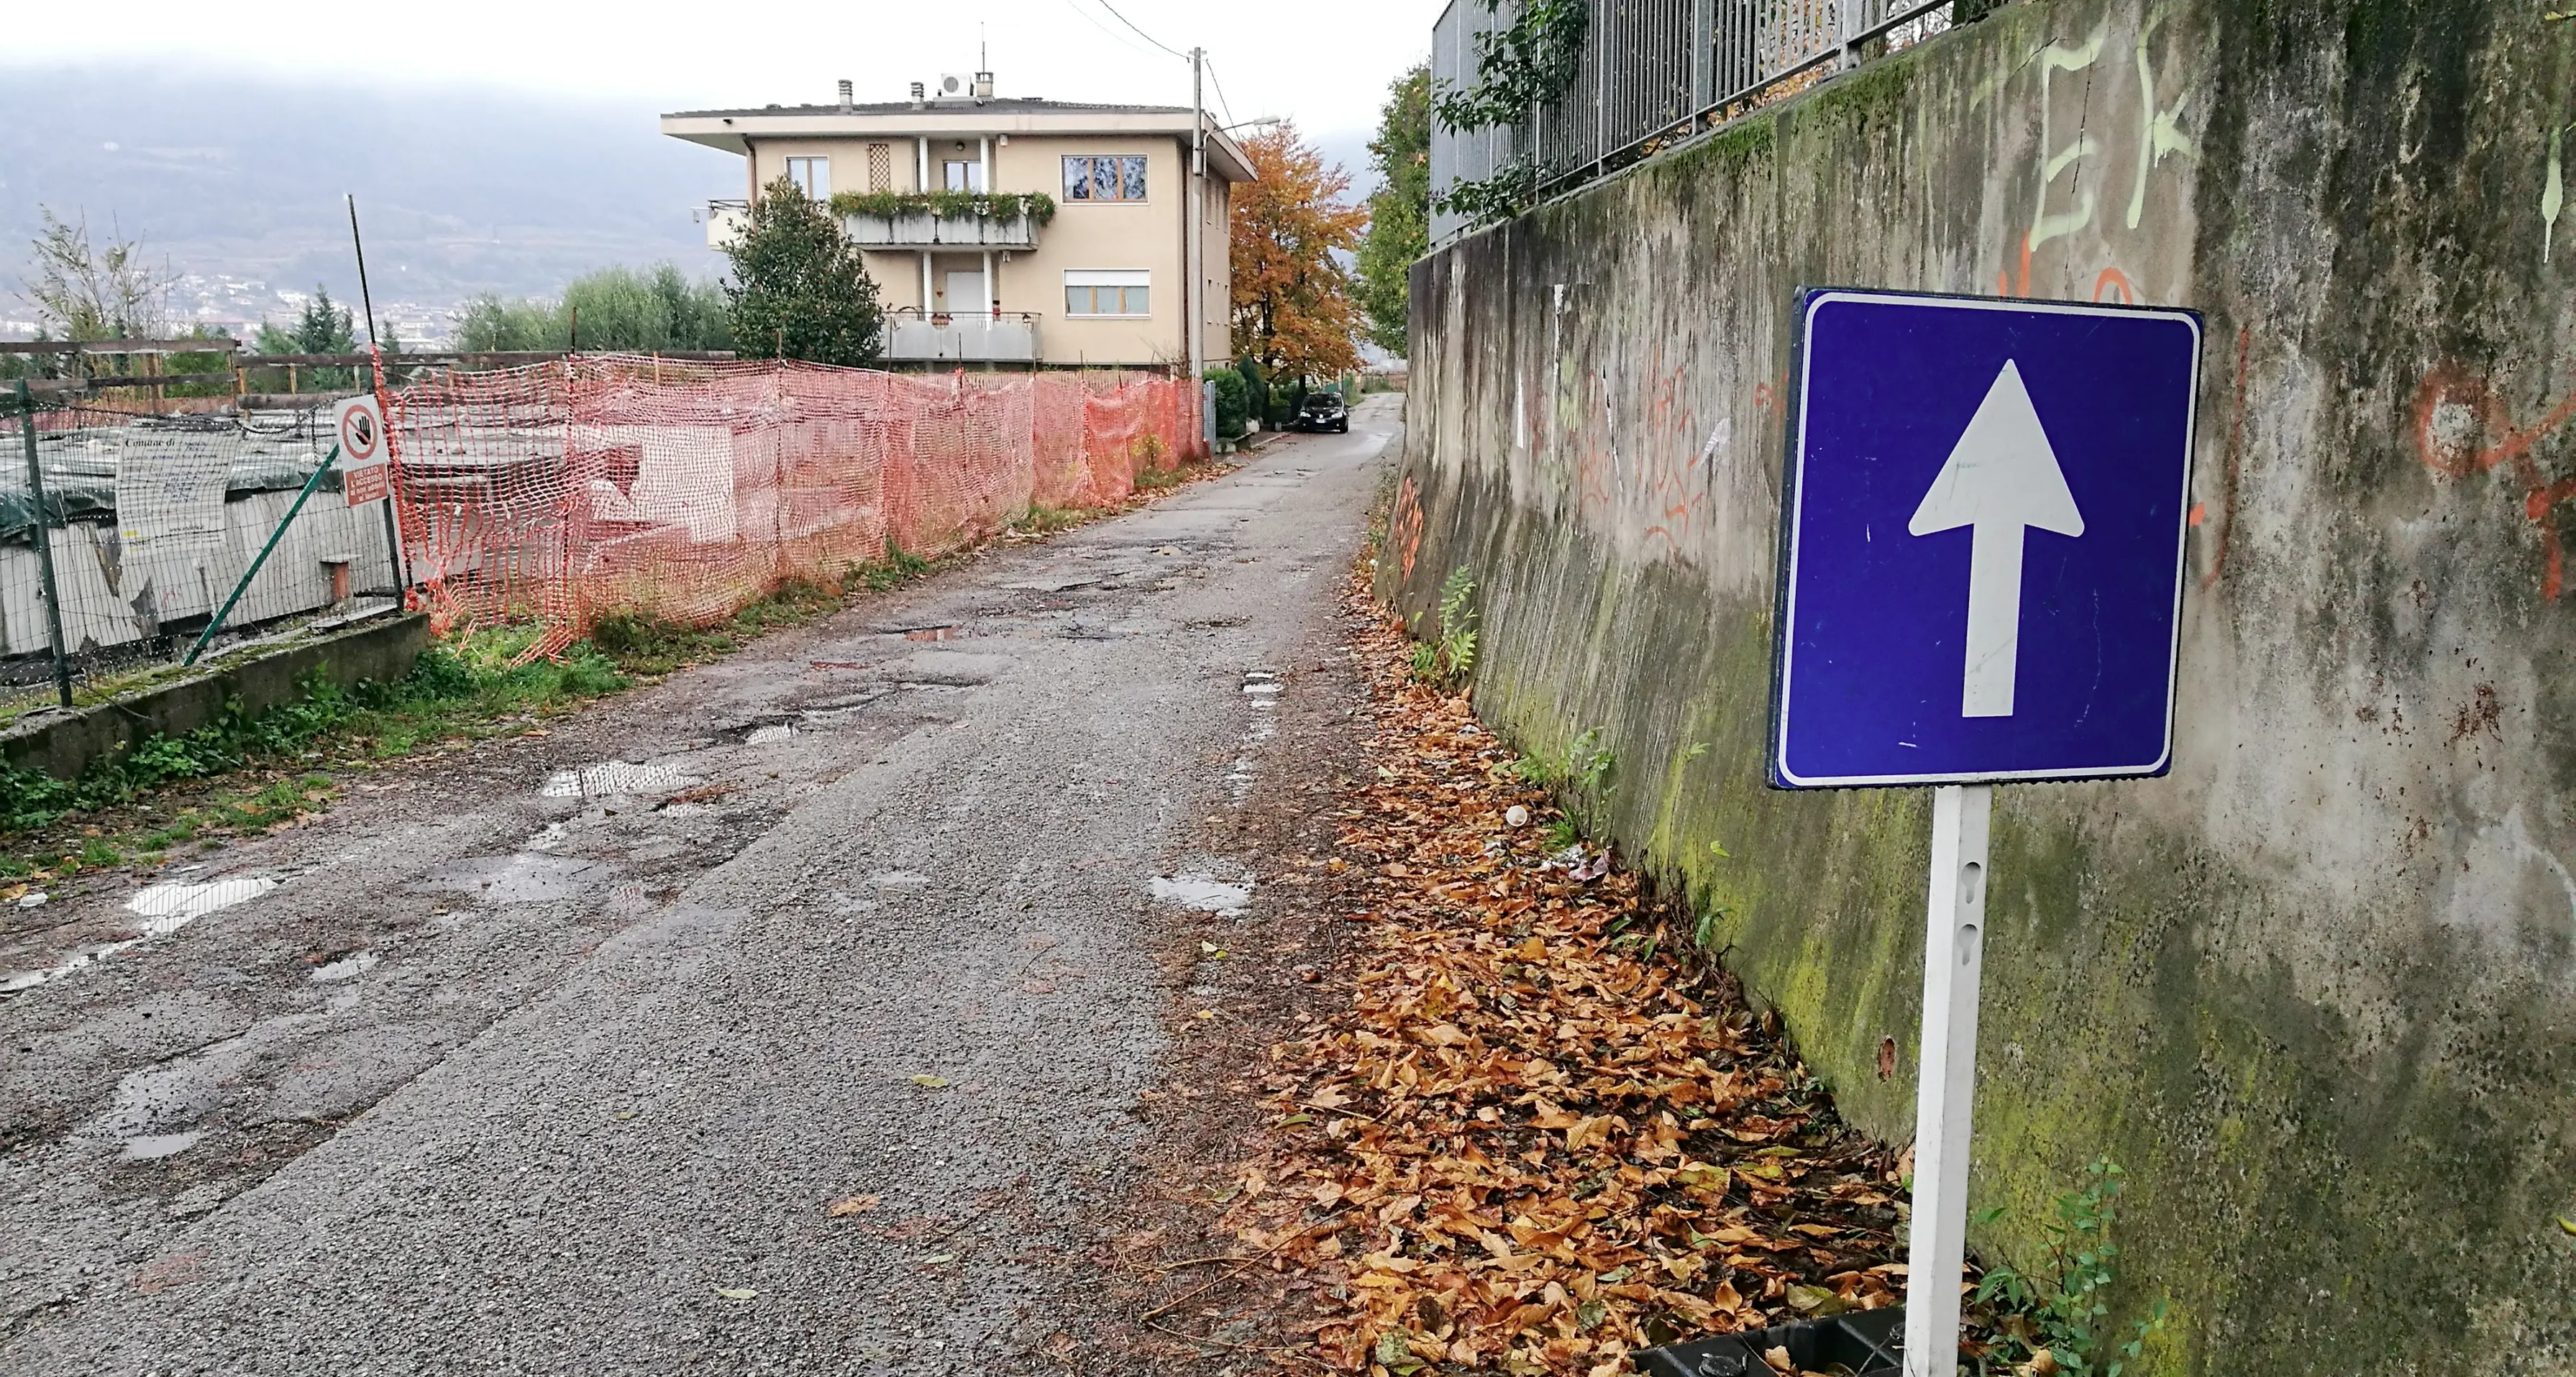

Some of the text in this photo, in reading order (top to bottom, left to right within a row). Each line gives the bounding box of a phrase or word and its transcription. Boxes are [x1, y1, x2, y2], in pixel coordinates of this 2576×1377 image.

[166, 438, 175, 447] di
[353, 466, 378, 478] VIETATO
[351, 473, 383, 488] L'ACCESSO
